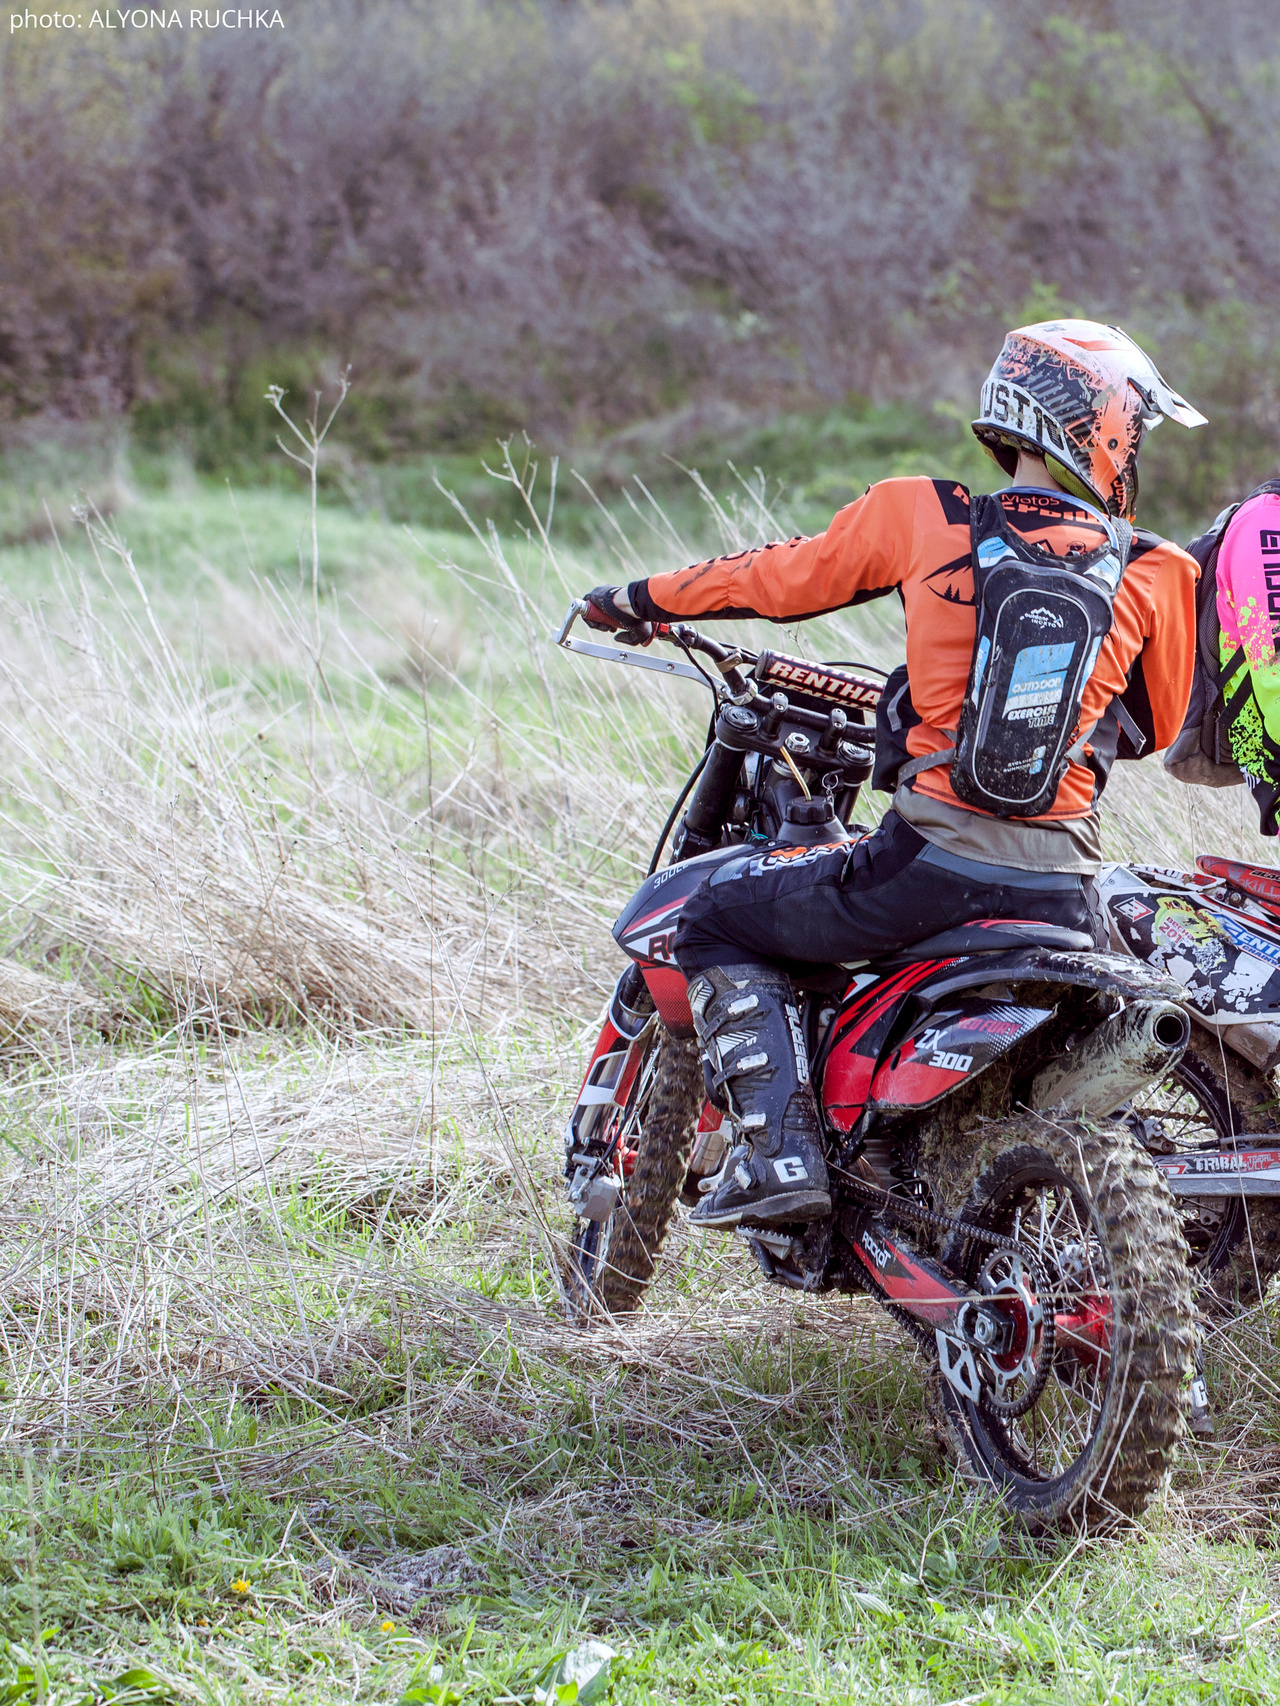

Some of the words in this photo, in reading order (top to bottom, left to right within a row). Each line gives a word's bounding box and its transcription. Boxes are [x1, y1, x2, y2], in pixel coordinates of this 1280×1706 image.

[768, 660, 882, 706] RENTHA
[914, 1028, 949, 1050] ZX
[928, 1050, 974, 1073] 300
[773, 1157, 809, 1184] G
